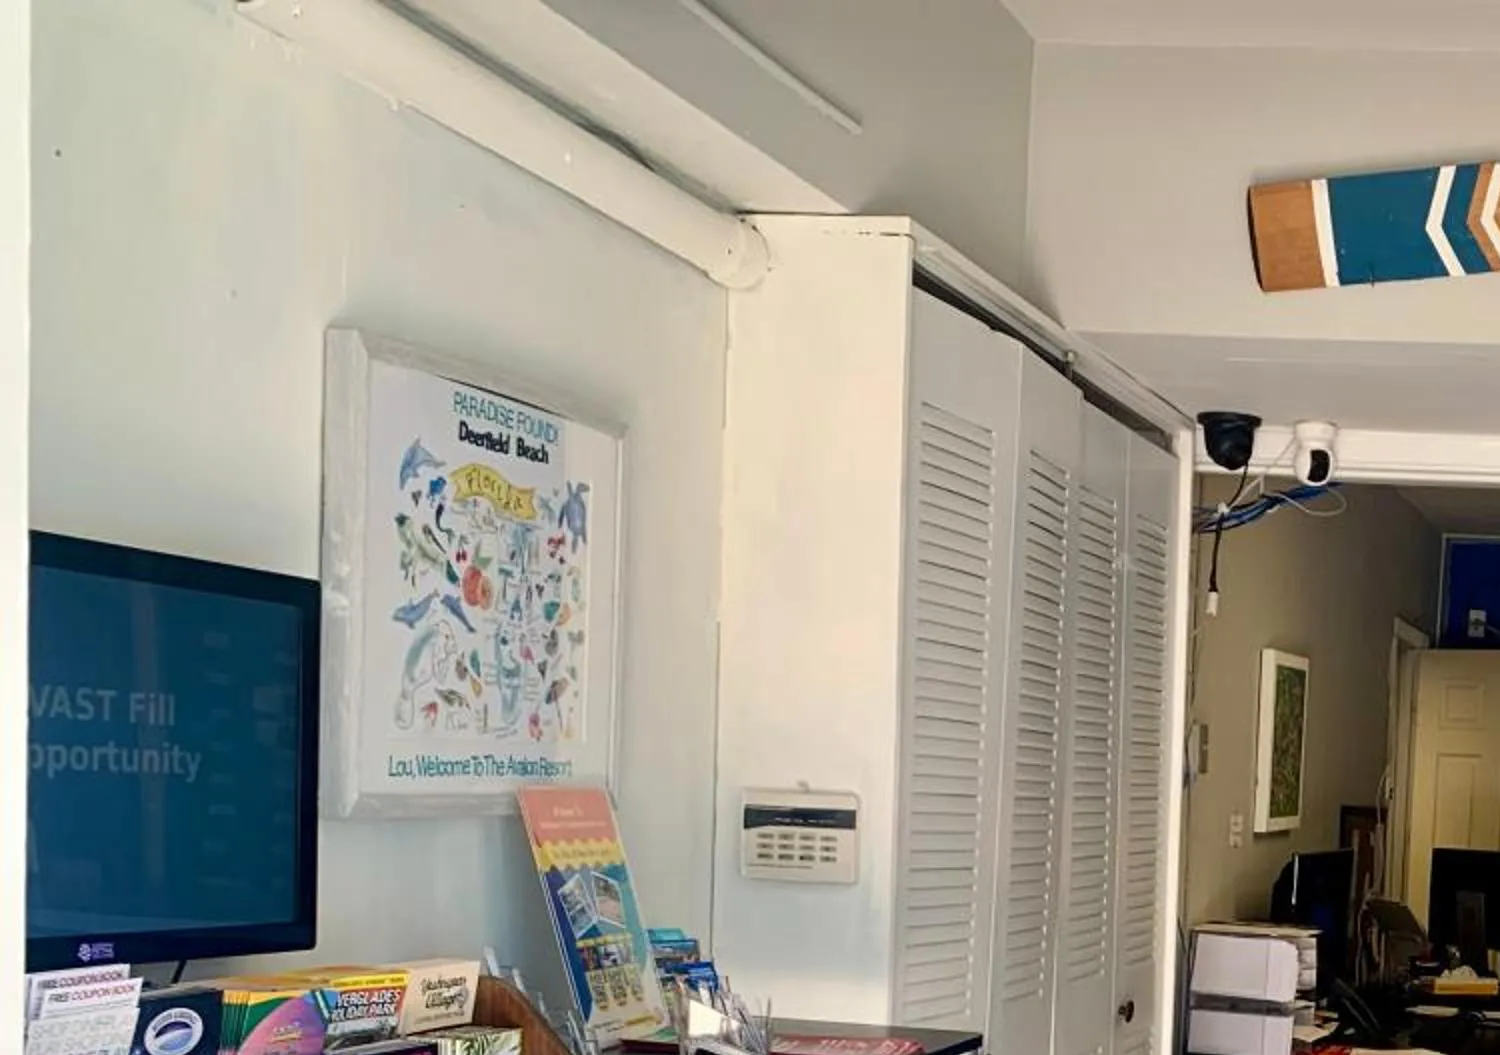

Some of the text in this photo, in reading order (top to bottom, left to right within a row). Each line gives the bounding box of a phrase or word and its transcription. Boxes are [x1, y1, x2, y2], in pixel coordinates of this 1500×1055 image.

[453, 390, 515, 430] PARADISE
[458, 420, 549, 464] Deerfield Beach
[129, 691, 176, 726] Fill
[416, 754, 471, 777] Welcome
[471, 755, 484, 777] To
[484, 754, 505, 776] The
[48, 983, 136, 1003] FREE COUPON BOOK
